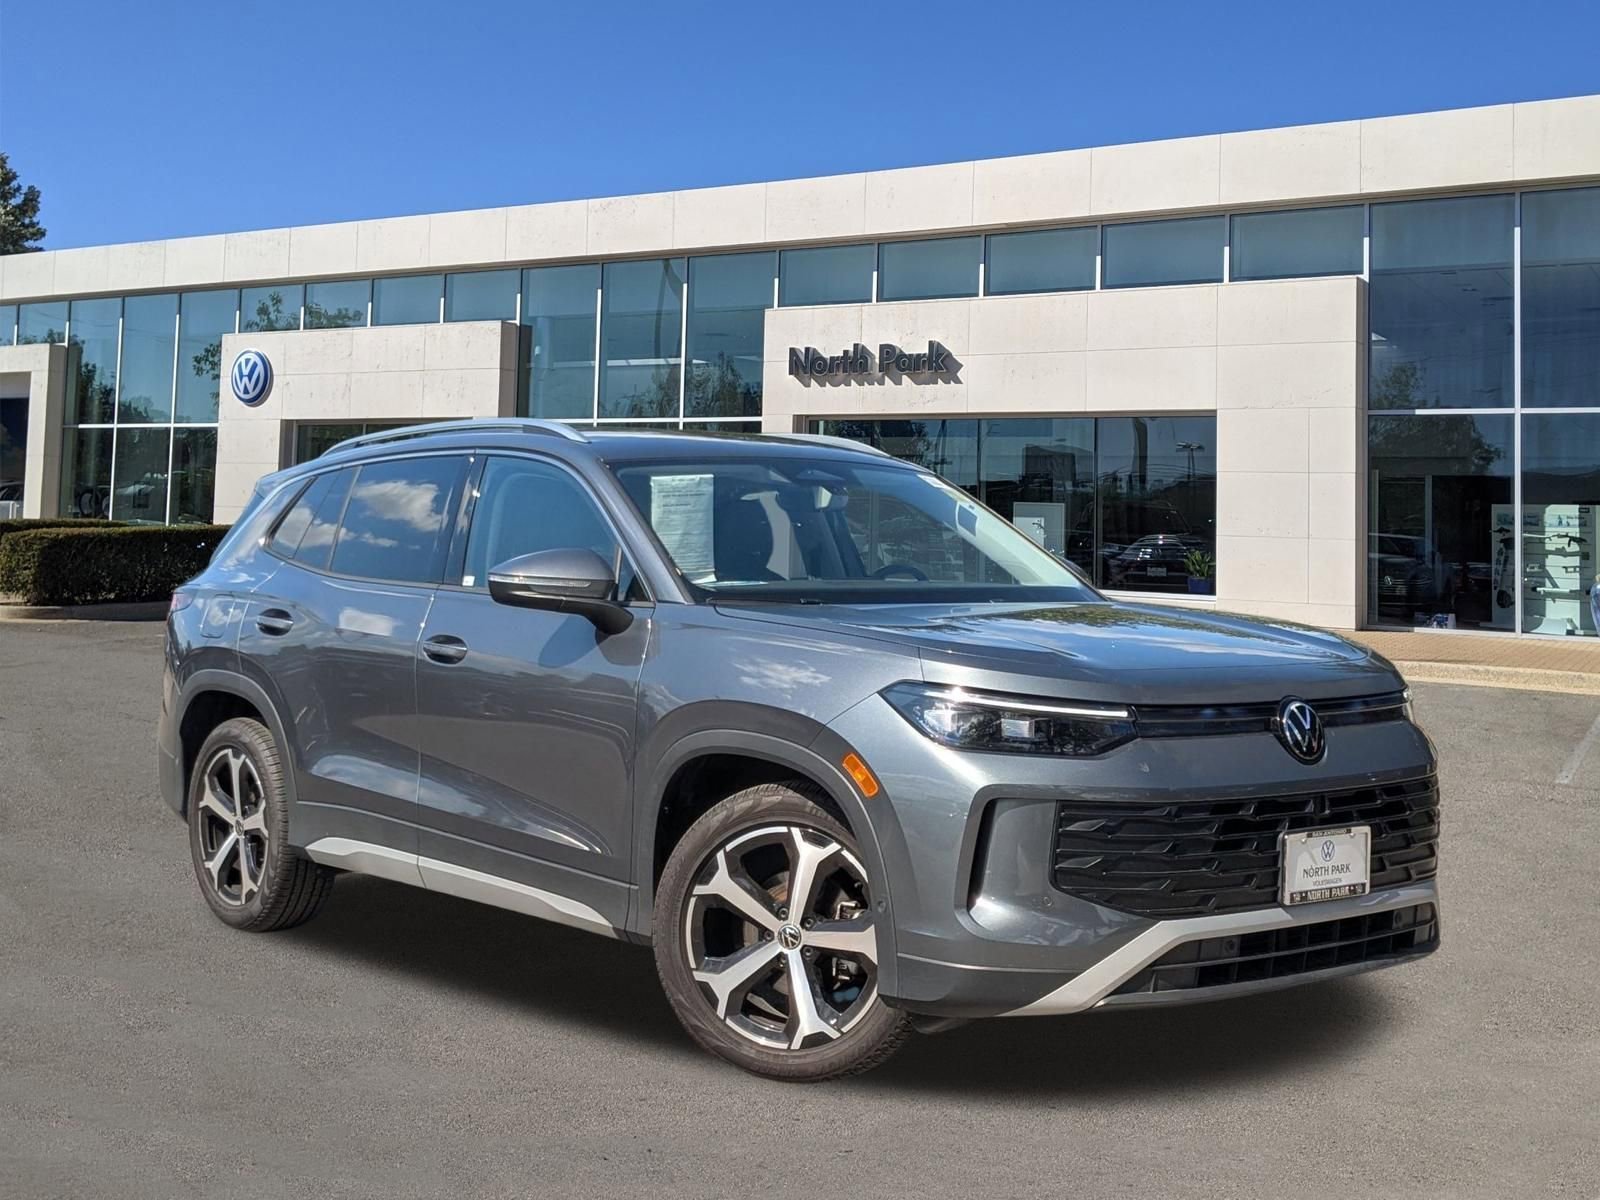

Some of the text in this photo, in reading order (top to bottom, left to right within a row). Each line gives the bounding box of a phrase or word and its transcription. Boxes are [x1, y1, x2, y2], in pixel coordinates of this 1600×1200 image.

[788, 340, 950, 376] North Park
[232, 351, 268, 403] VW
[1283, 701, 1324, 760] VW
[1303, 864, 1351, 878] NORTH PARK
[1307, 886, 1351, 901] NORTH PARK
